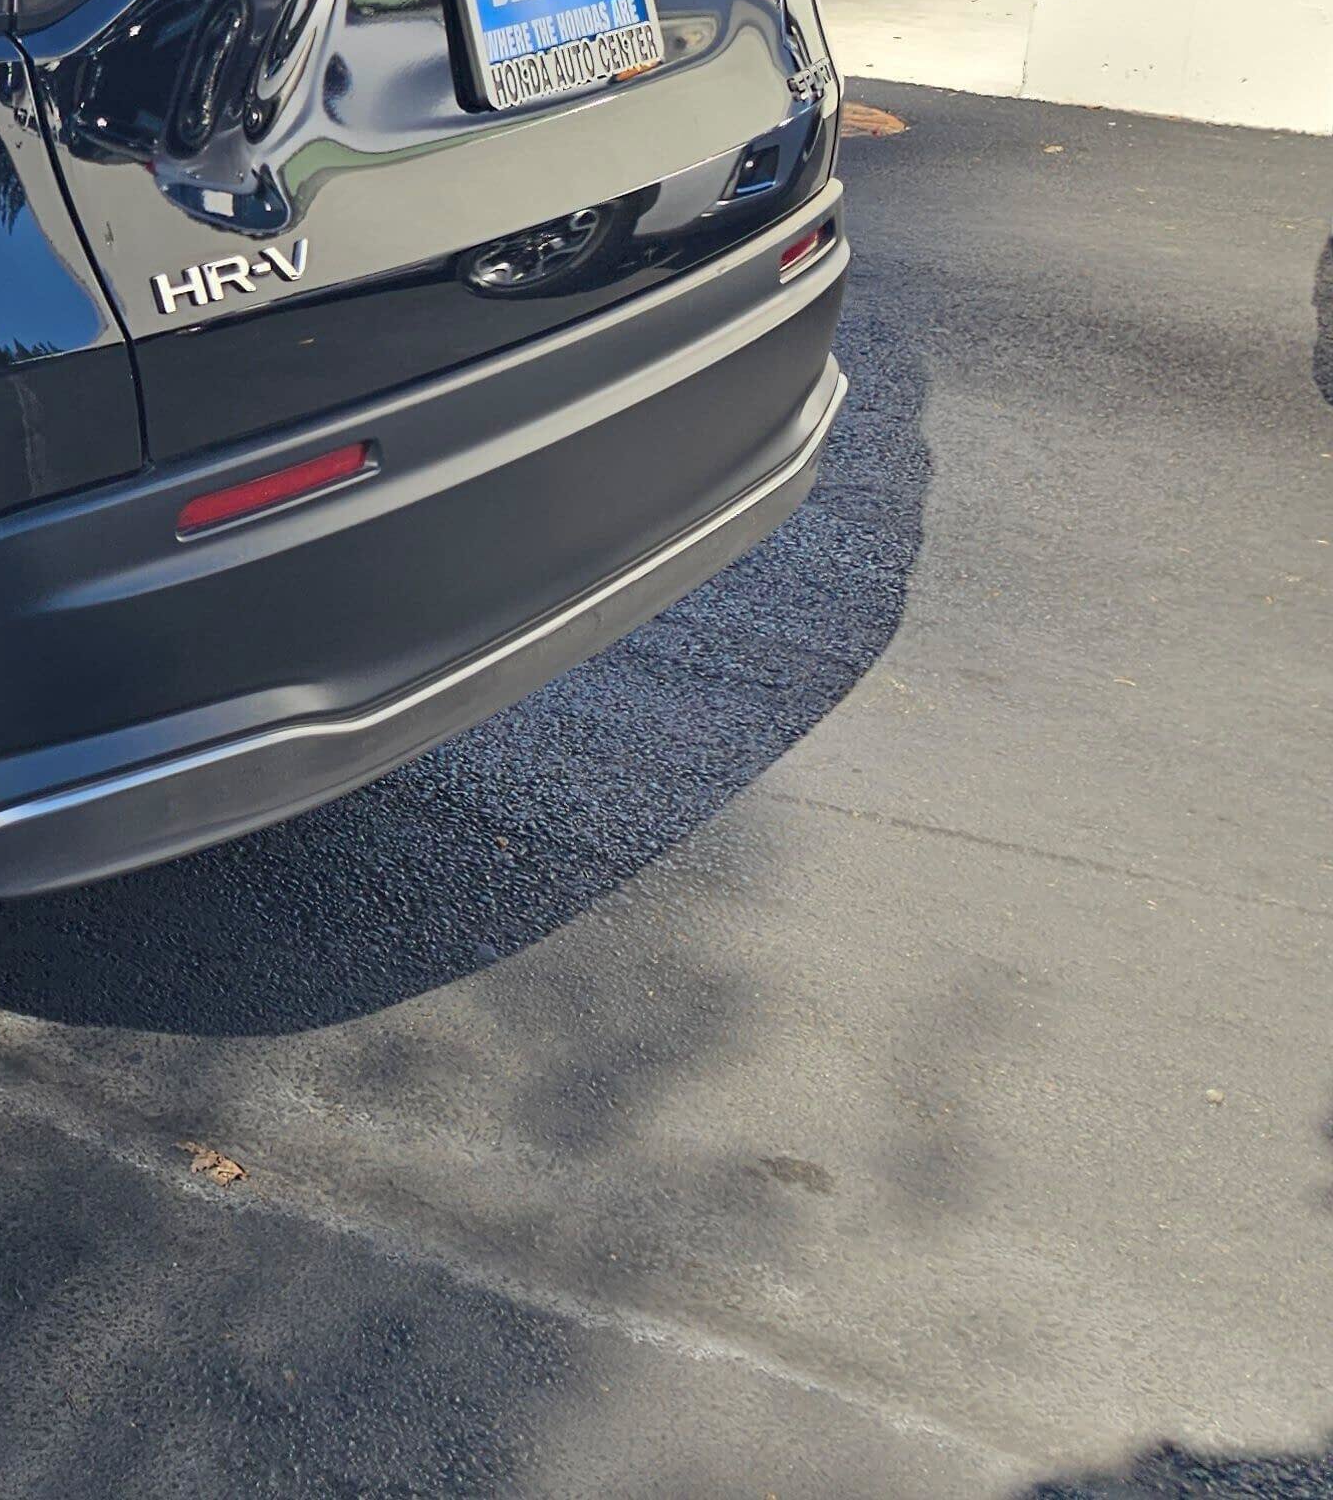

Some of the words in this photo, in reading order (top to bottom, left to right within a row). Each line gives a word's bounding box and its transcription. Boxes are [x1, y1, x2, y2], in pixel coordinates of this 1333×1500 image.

[484, 26, 533, 62] WHERE
[532, 18, 556, 47] THE
[557, 5, 610, 41] HONDAS
[492, 55, 554, 107] HONDA
[555, 41, 596, 86] AUTO
[598, 24, 659, 71] CENTER
[151, 238, 308, 314] HR-V
